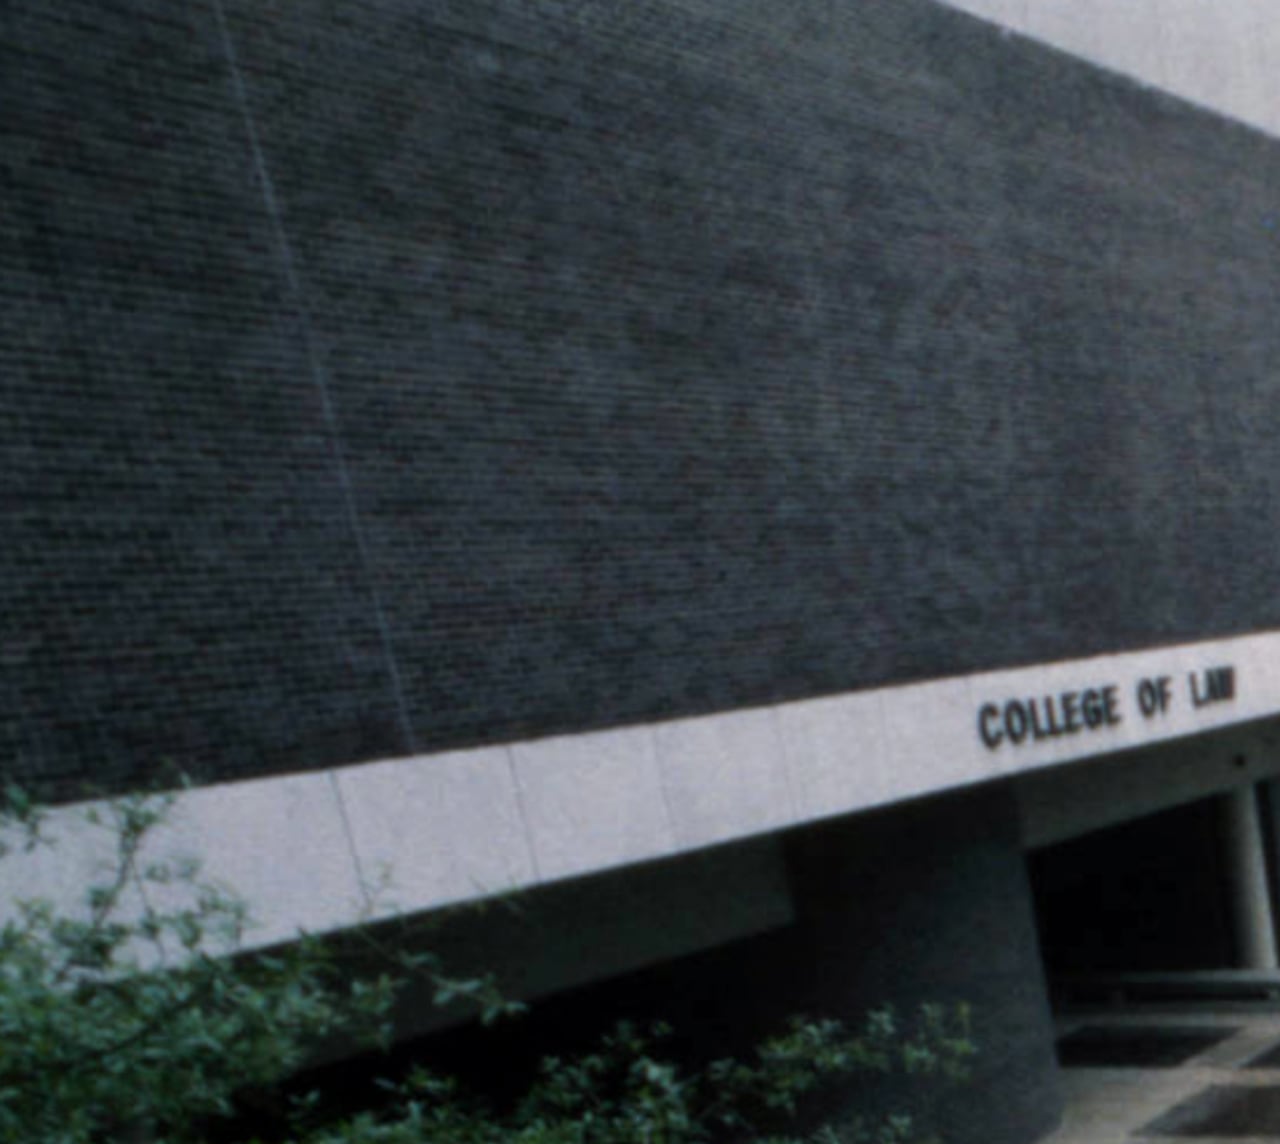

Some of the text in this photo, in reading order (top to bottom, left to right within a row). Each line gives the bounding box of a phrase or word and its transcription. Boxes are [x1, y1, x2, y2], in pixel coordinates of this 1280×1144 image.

[977, 665, 1237, 749] COLLEGE OF LAW
